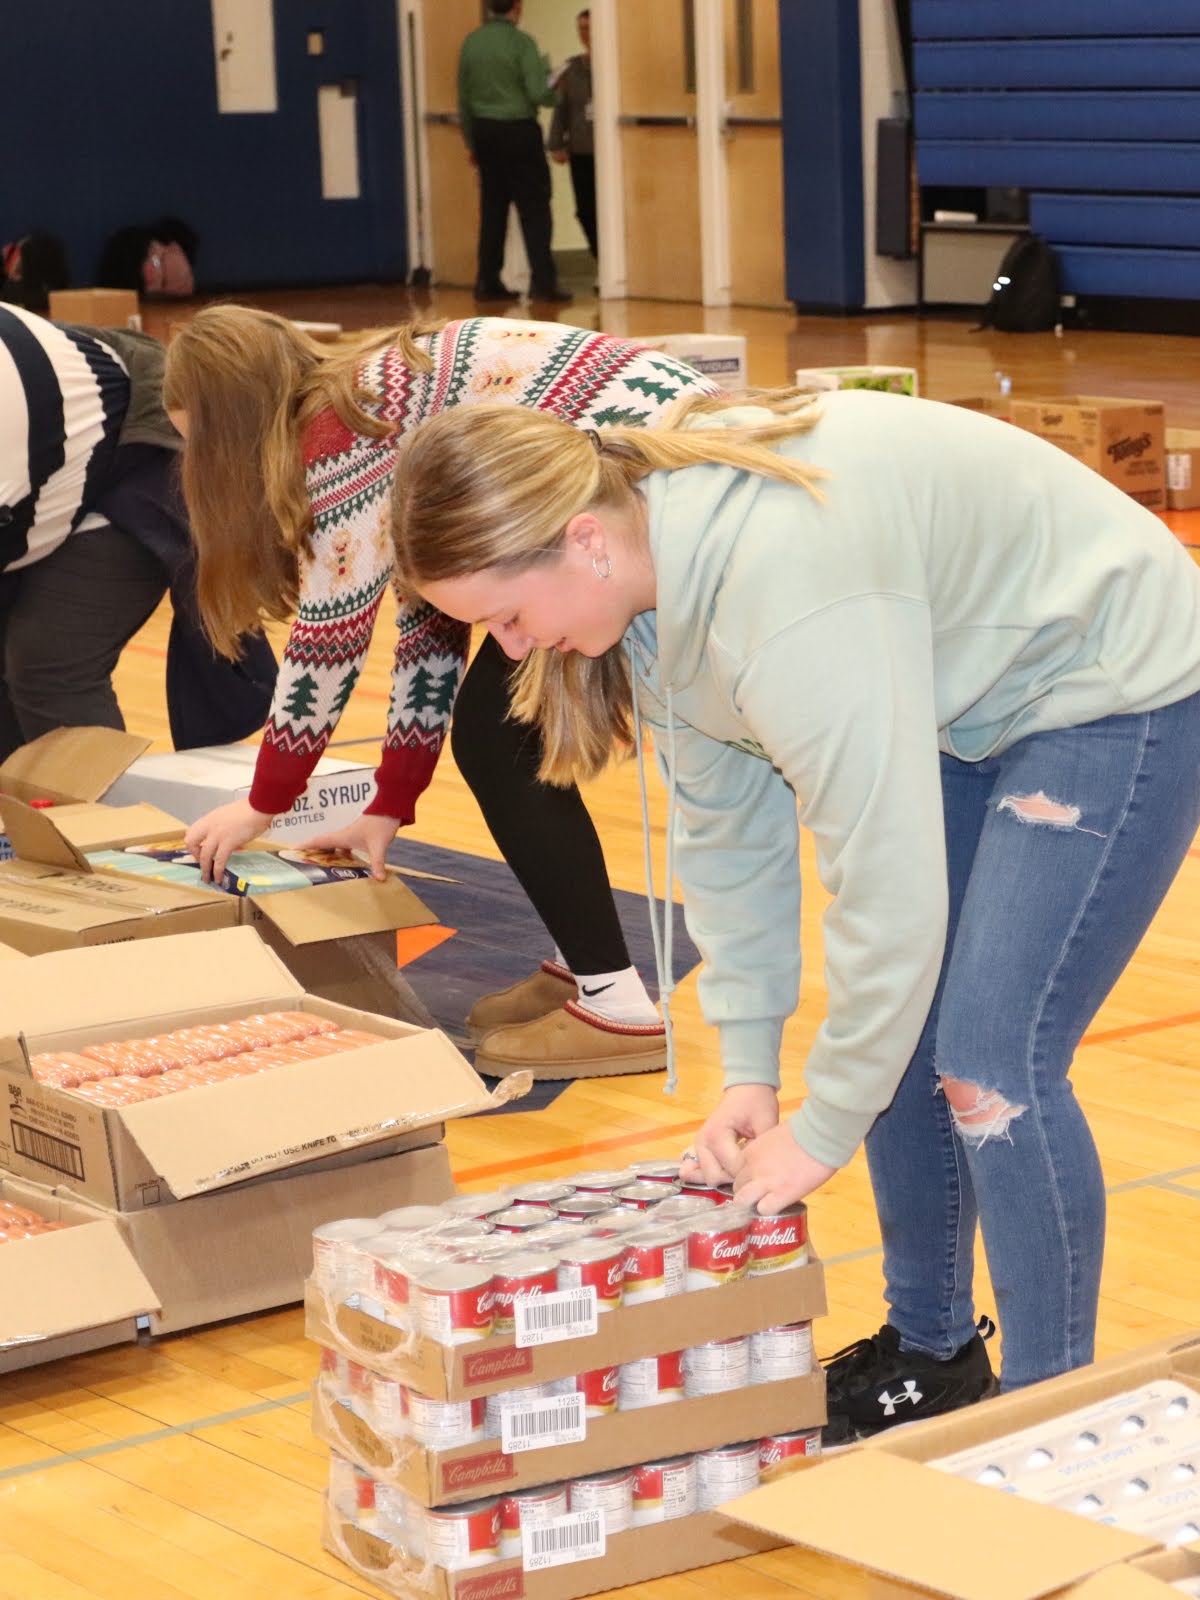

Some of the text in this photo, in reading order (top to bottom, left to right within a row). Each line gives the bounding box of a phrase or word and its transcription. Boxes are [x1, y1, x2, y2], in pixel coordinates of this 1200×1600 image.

[319, 782, 371, 808] SYRUP
[284, 812, 325, 827] BOTTLES
[301, 1138, 325, 1150] KNIFE
[326, 1135, 337, 1144] TO
[570, 1288, 592, 1299] 11285
[557, 1395, 581, 1406] 11285
[508, 1439, 531, 1450] 11285
[578, 1511, 600, 1522] 11285
[529, 1556, 551, 1567] 11285
